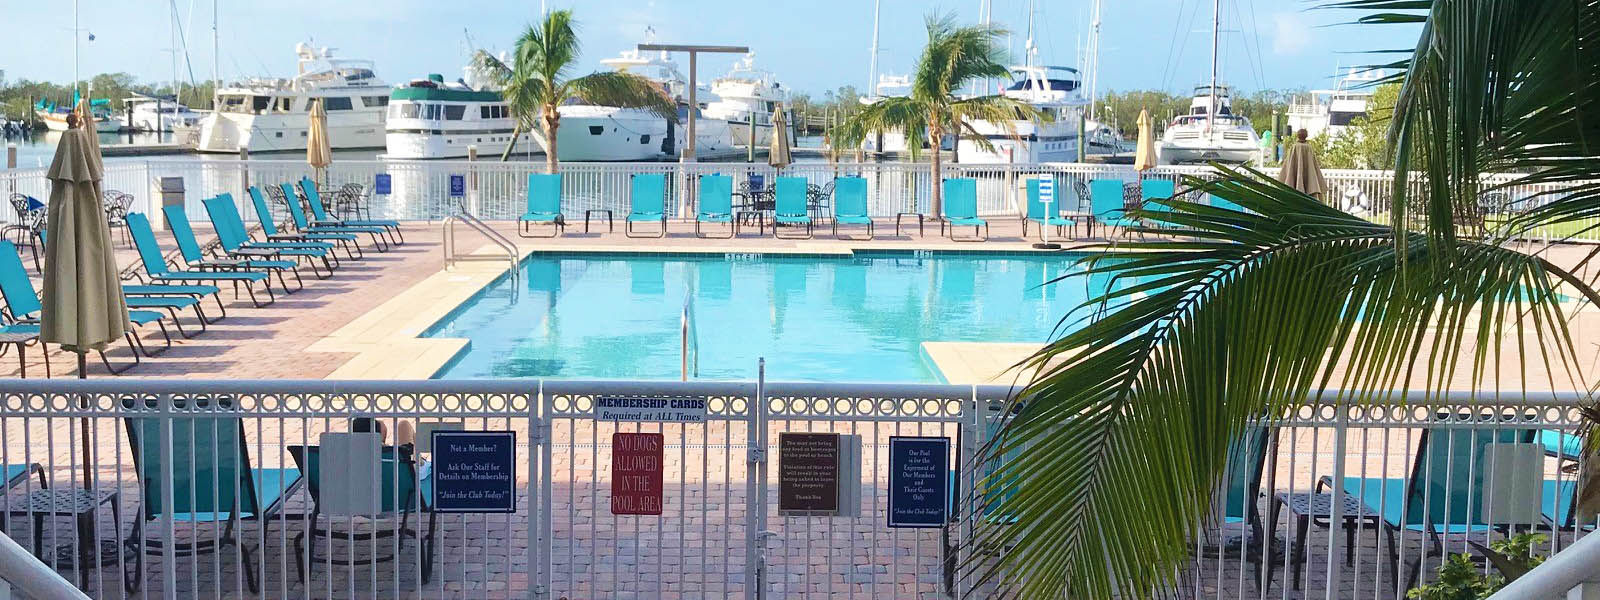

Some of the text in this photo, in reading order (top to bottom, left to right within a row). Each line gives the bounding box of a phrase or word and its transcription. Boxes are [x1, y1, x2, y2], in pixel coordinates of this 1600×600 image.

[598, 398, 705, 409] MEMBERSHIP CARDS
[602, 411, 701, 421] Required at ALL Times
[450, 444, 462, 452] Not
[468, 444, 497, 452] Member?
[618, 435, 658, 451] NO DOGS
[448, 463, 500, 471] Ask Our Staff for
[615, 456, 657, 471] ALLOWED
[439, 472, 460, 480] Details
[470, 472, 509, 481] Membership
[621, 475, 650, 491] IN THE
[457, 490, 467, 498] the
[468, 490, 482, 499] Club
[612, 496, 661, 512] POOL AREA
